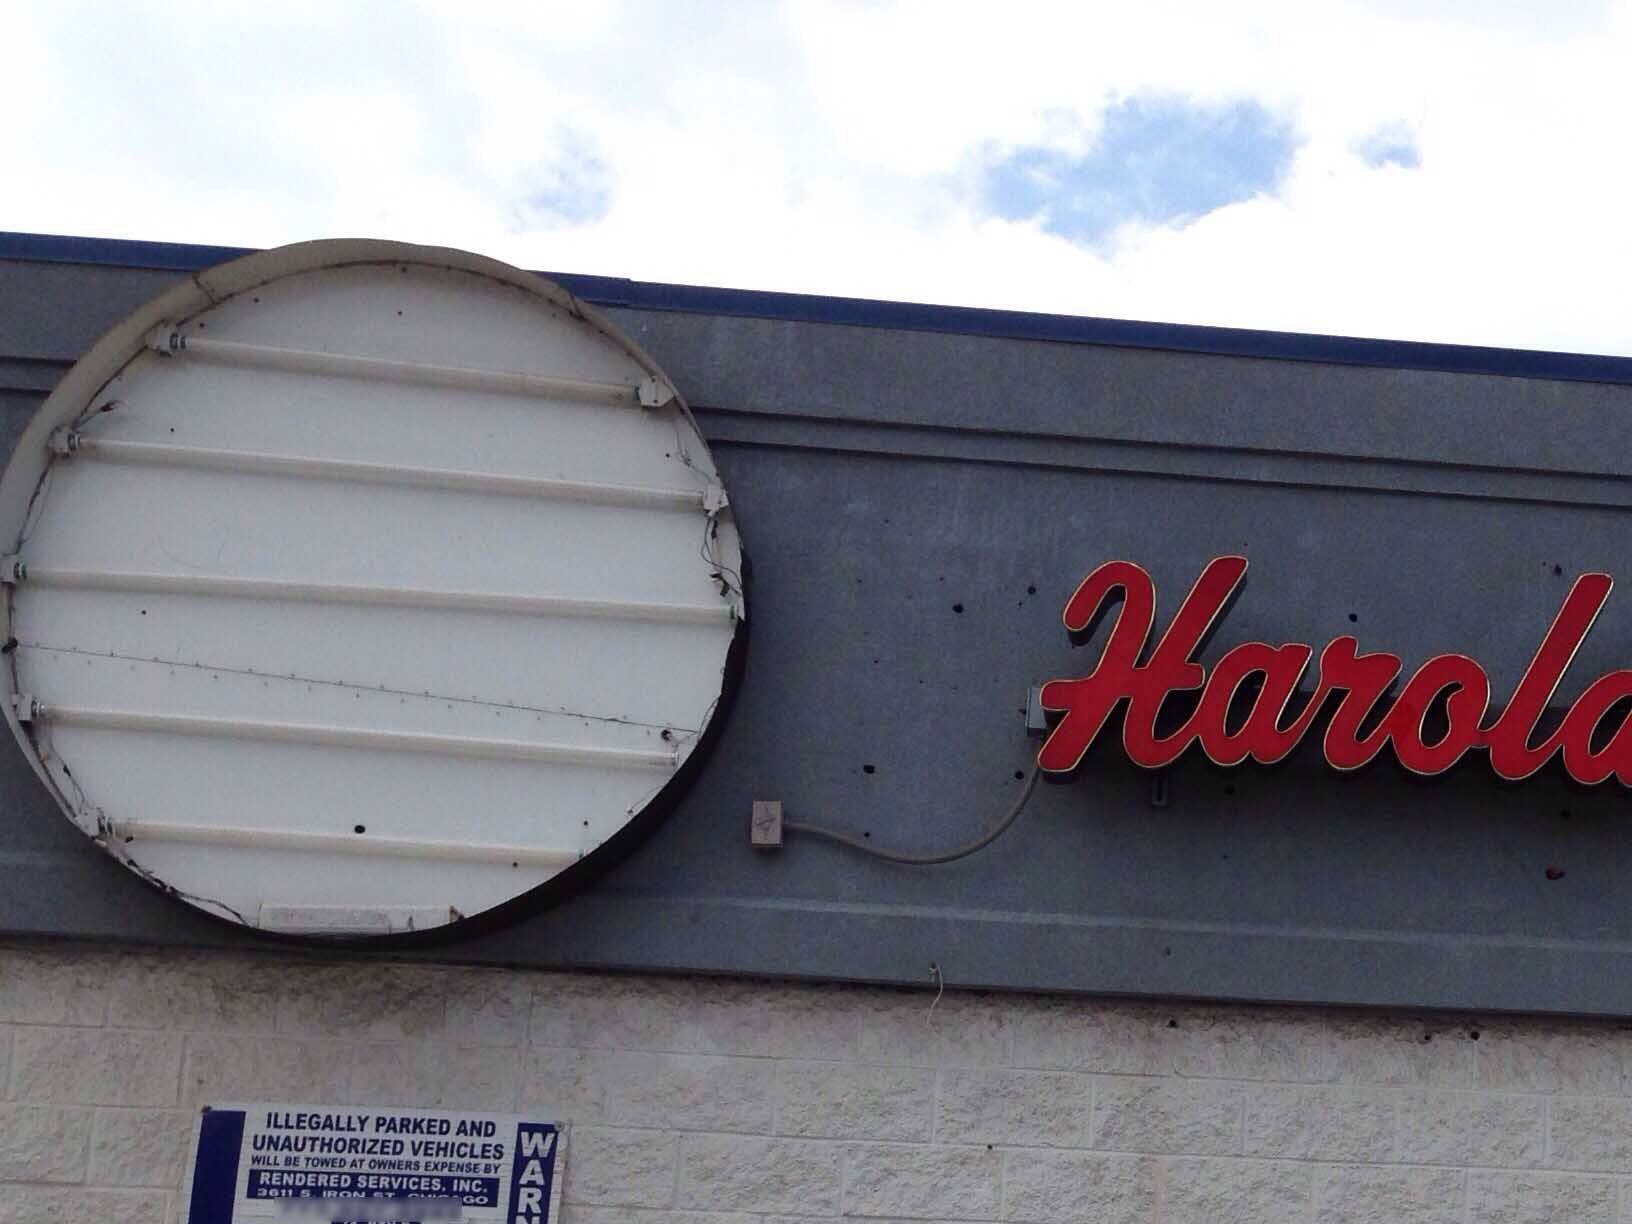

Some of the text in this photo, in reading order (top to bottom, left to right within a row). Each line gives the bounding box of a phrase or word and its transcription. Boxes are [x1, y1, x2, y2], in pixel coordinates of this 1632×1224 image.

[266, 1112, 496, 1137] ILLEGALLY PARKED AND
[252, 1133, 504, 1160] UNAUTHORIZED VEHICLES
[251, 1154, 501, 1174] WILL BE TOWED AT OWNERS EXPENSE BY
[260, 1172, 351, 1188] RENDERED
[453, 1179, 488, 1193] INC.
[322, 1190, 366, 1198] IRON
